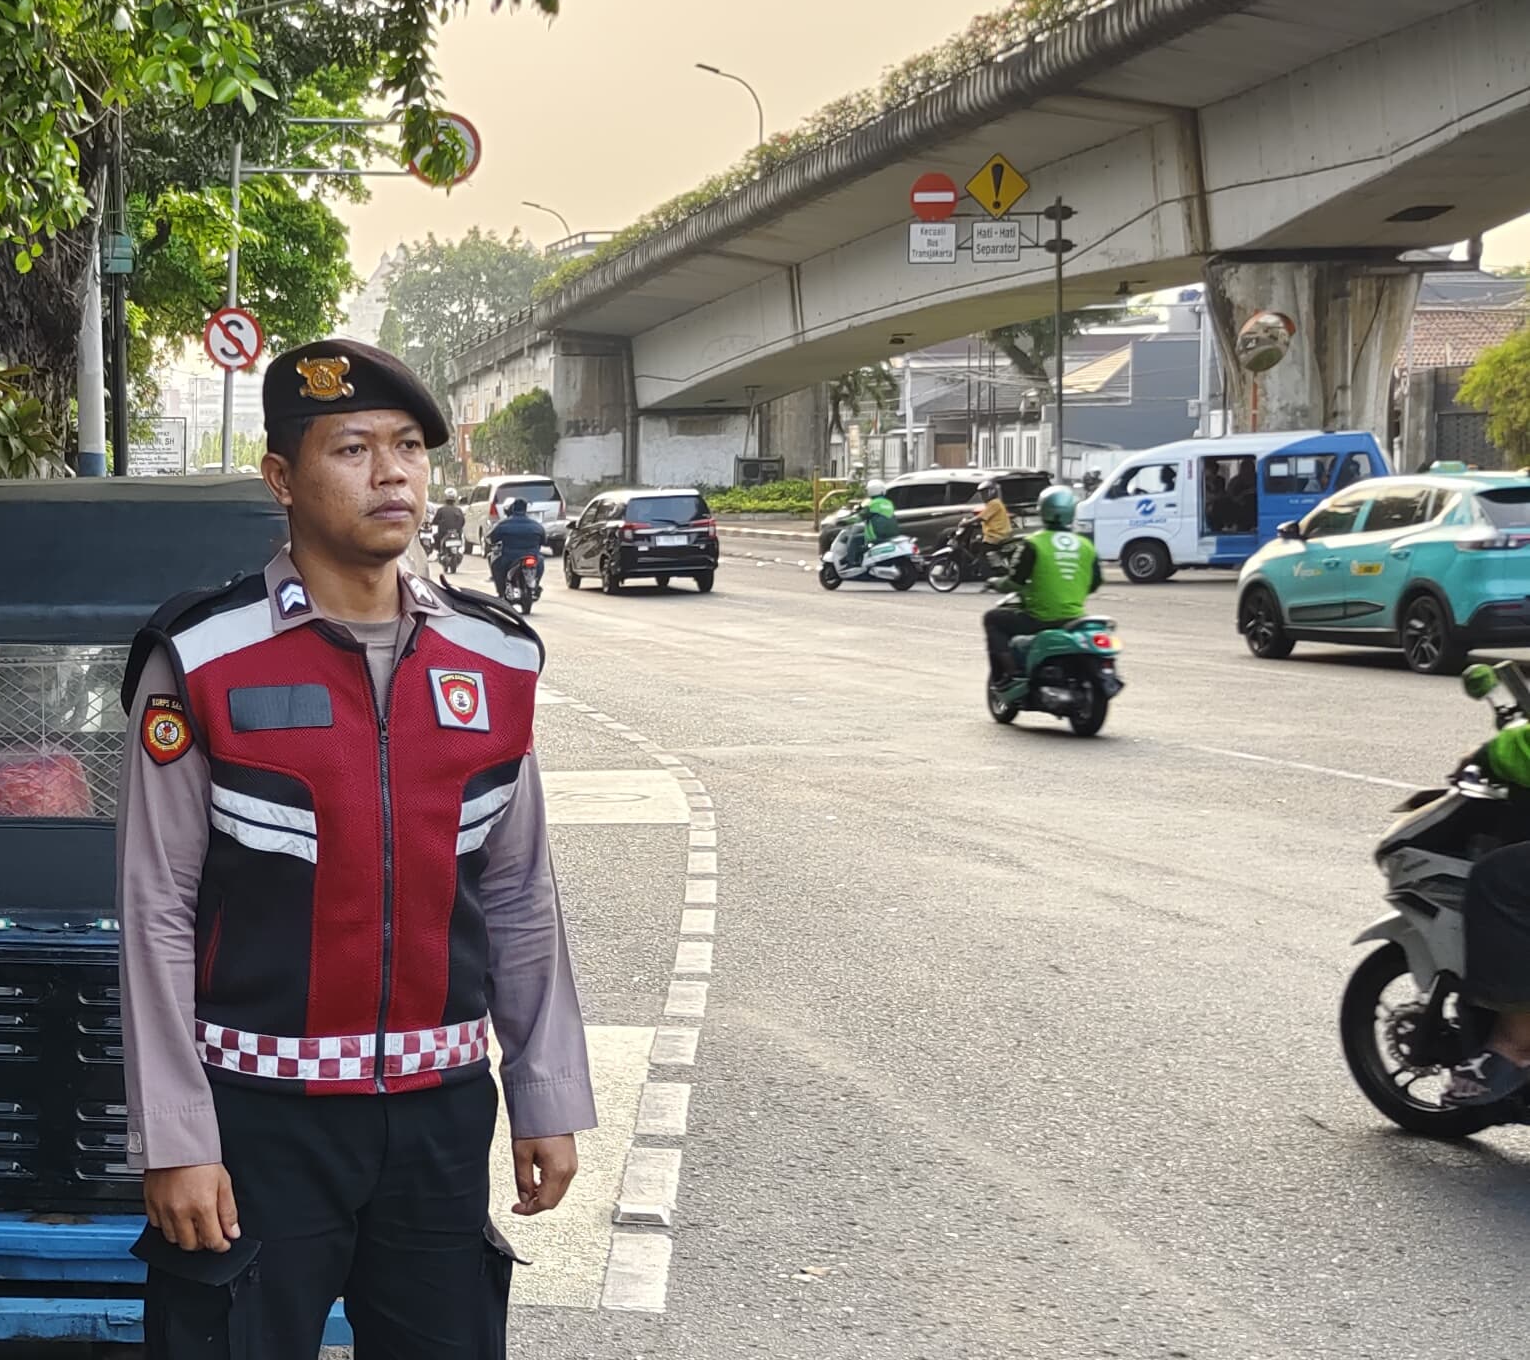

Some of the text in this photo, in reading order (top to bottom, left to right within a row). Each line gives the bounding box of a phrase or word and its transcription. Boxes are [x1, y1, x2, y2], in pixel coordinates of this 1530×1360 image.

[976, 227, 993, 239] Hati
[1000, 226, 1016, 238] Hati
[976, 243, 1017, 256] Separator
